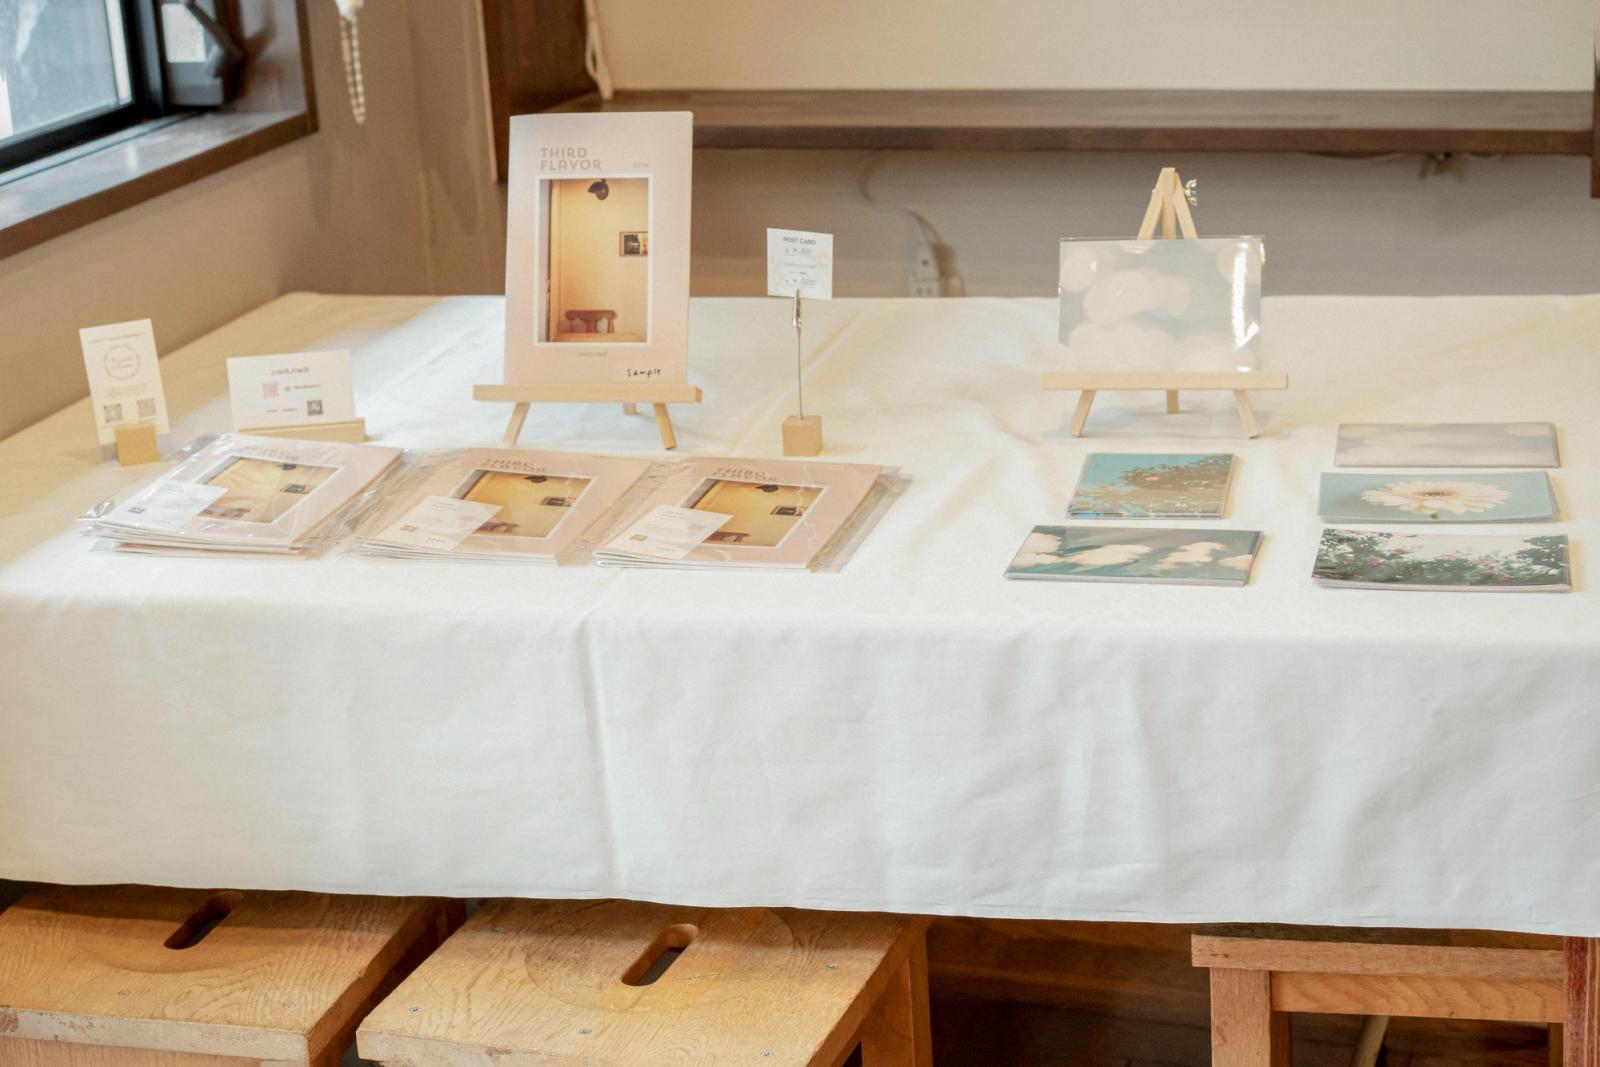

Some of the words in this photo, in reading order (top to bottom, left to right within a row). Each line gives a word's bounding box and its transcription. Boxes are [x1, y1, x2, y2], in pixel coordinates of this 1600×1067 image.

[540, 147, 588, 159] THIRD
[540, 160, 603, 171] FLAVOR
[783, 236, 799, 244] POST
